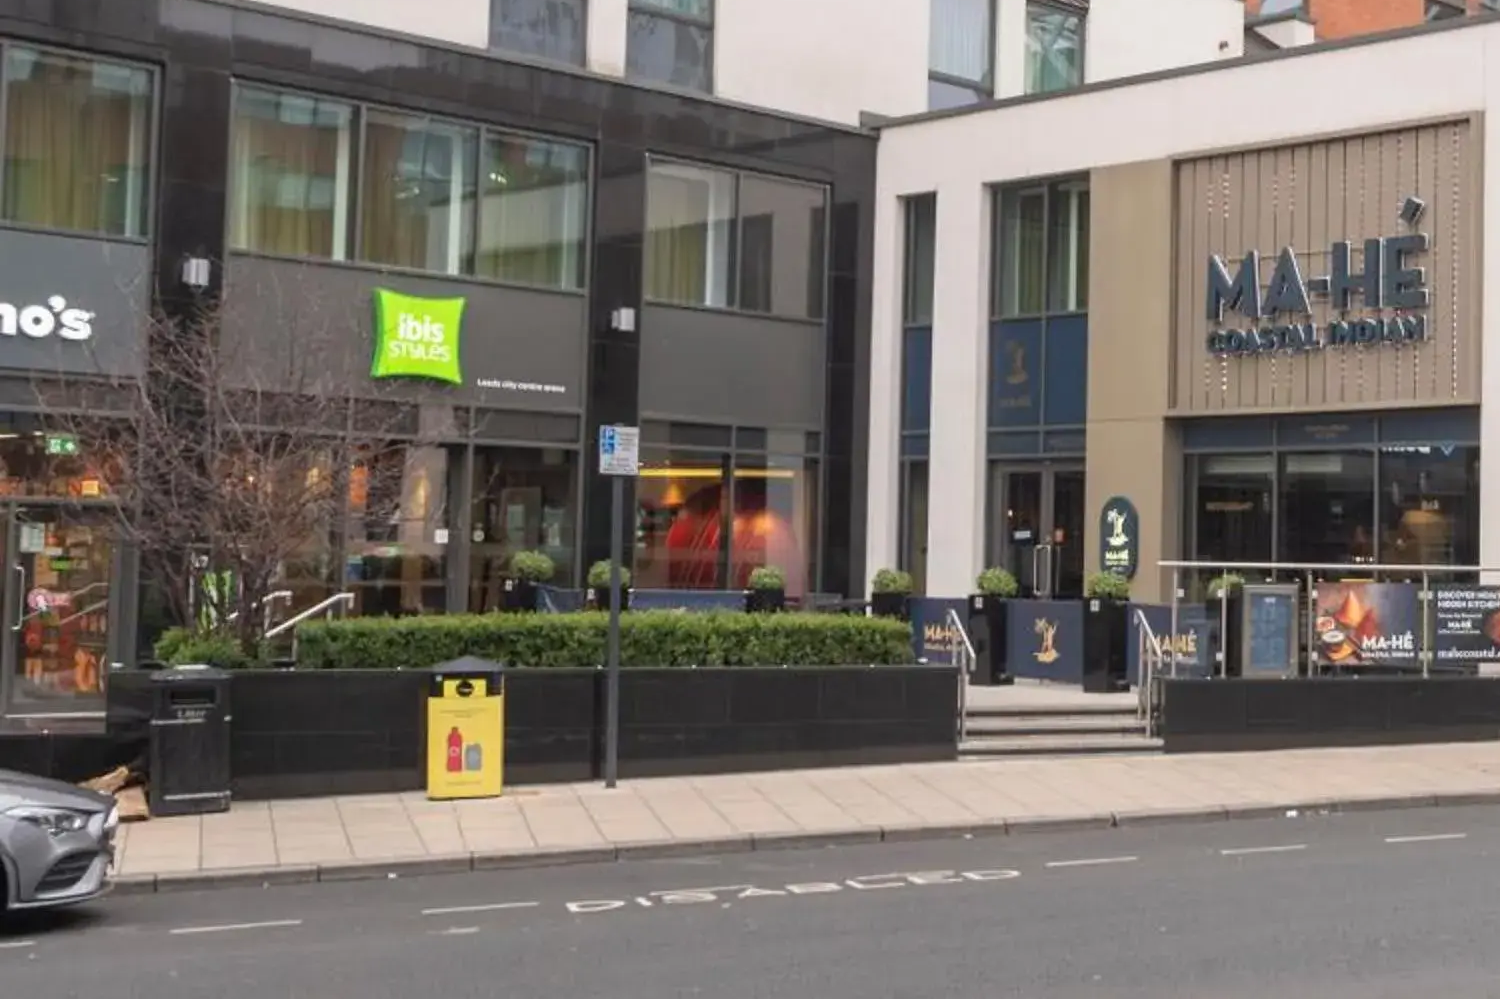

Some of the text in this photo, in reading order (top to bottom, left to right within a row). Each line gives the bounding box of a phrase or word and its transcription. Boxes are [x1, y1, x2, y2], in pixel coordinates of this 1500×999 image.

[1206, 196, 1430, 321] MA-HÉ
[397, 312, 446, 344] ibis
[1207, 314, 1428, 354] COASTAL INDIAN
[1361, 630, 1414, 650] MA-HÉ
